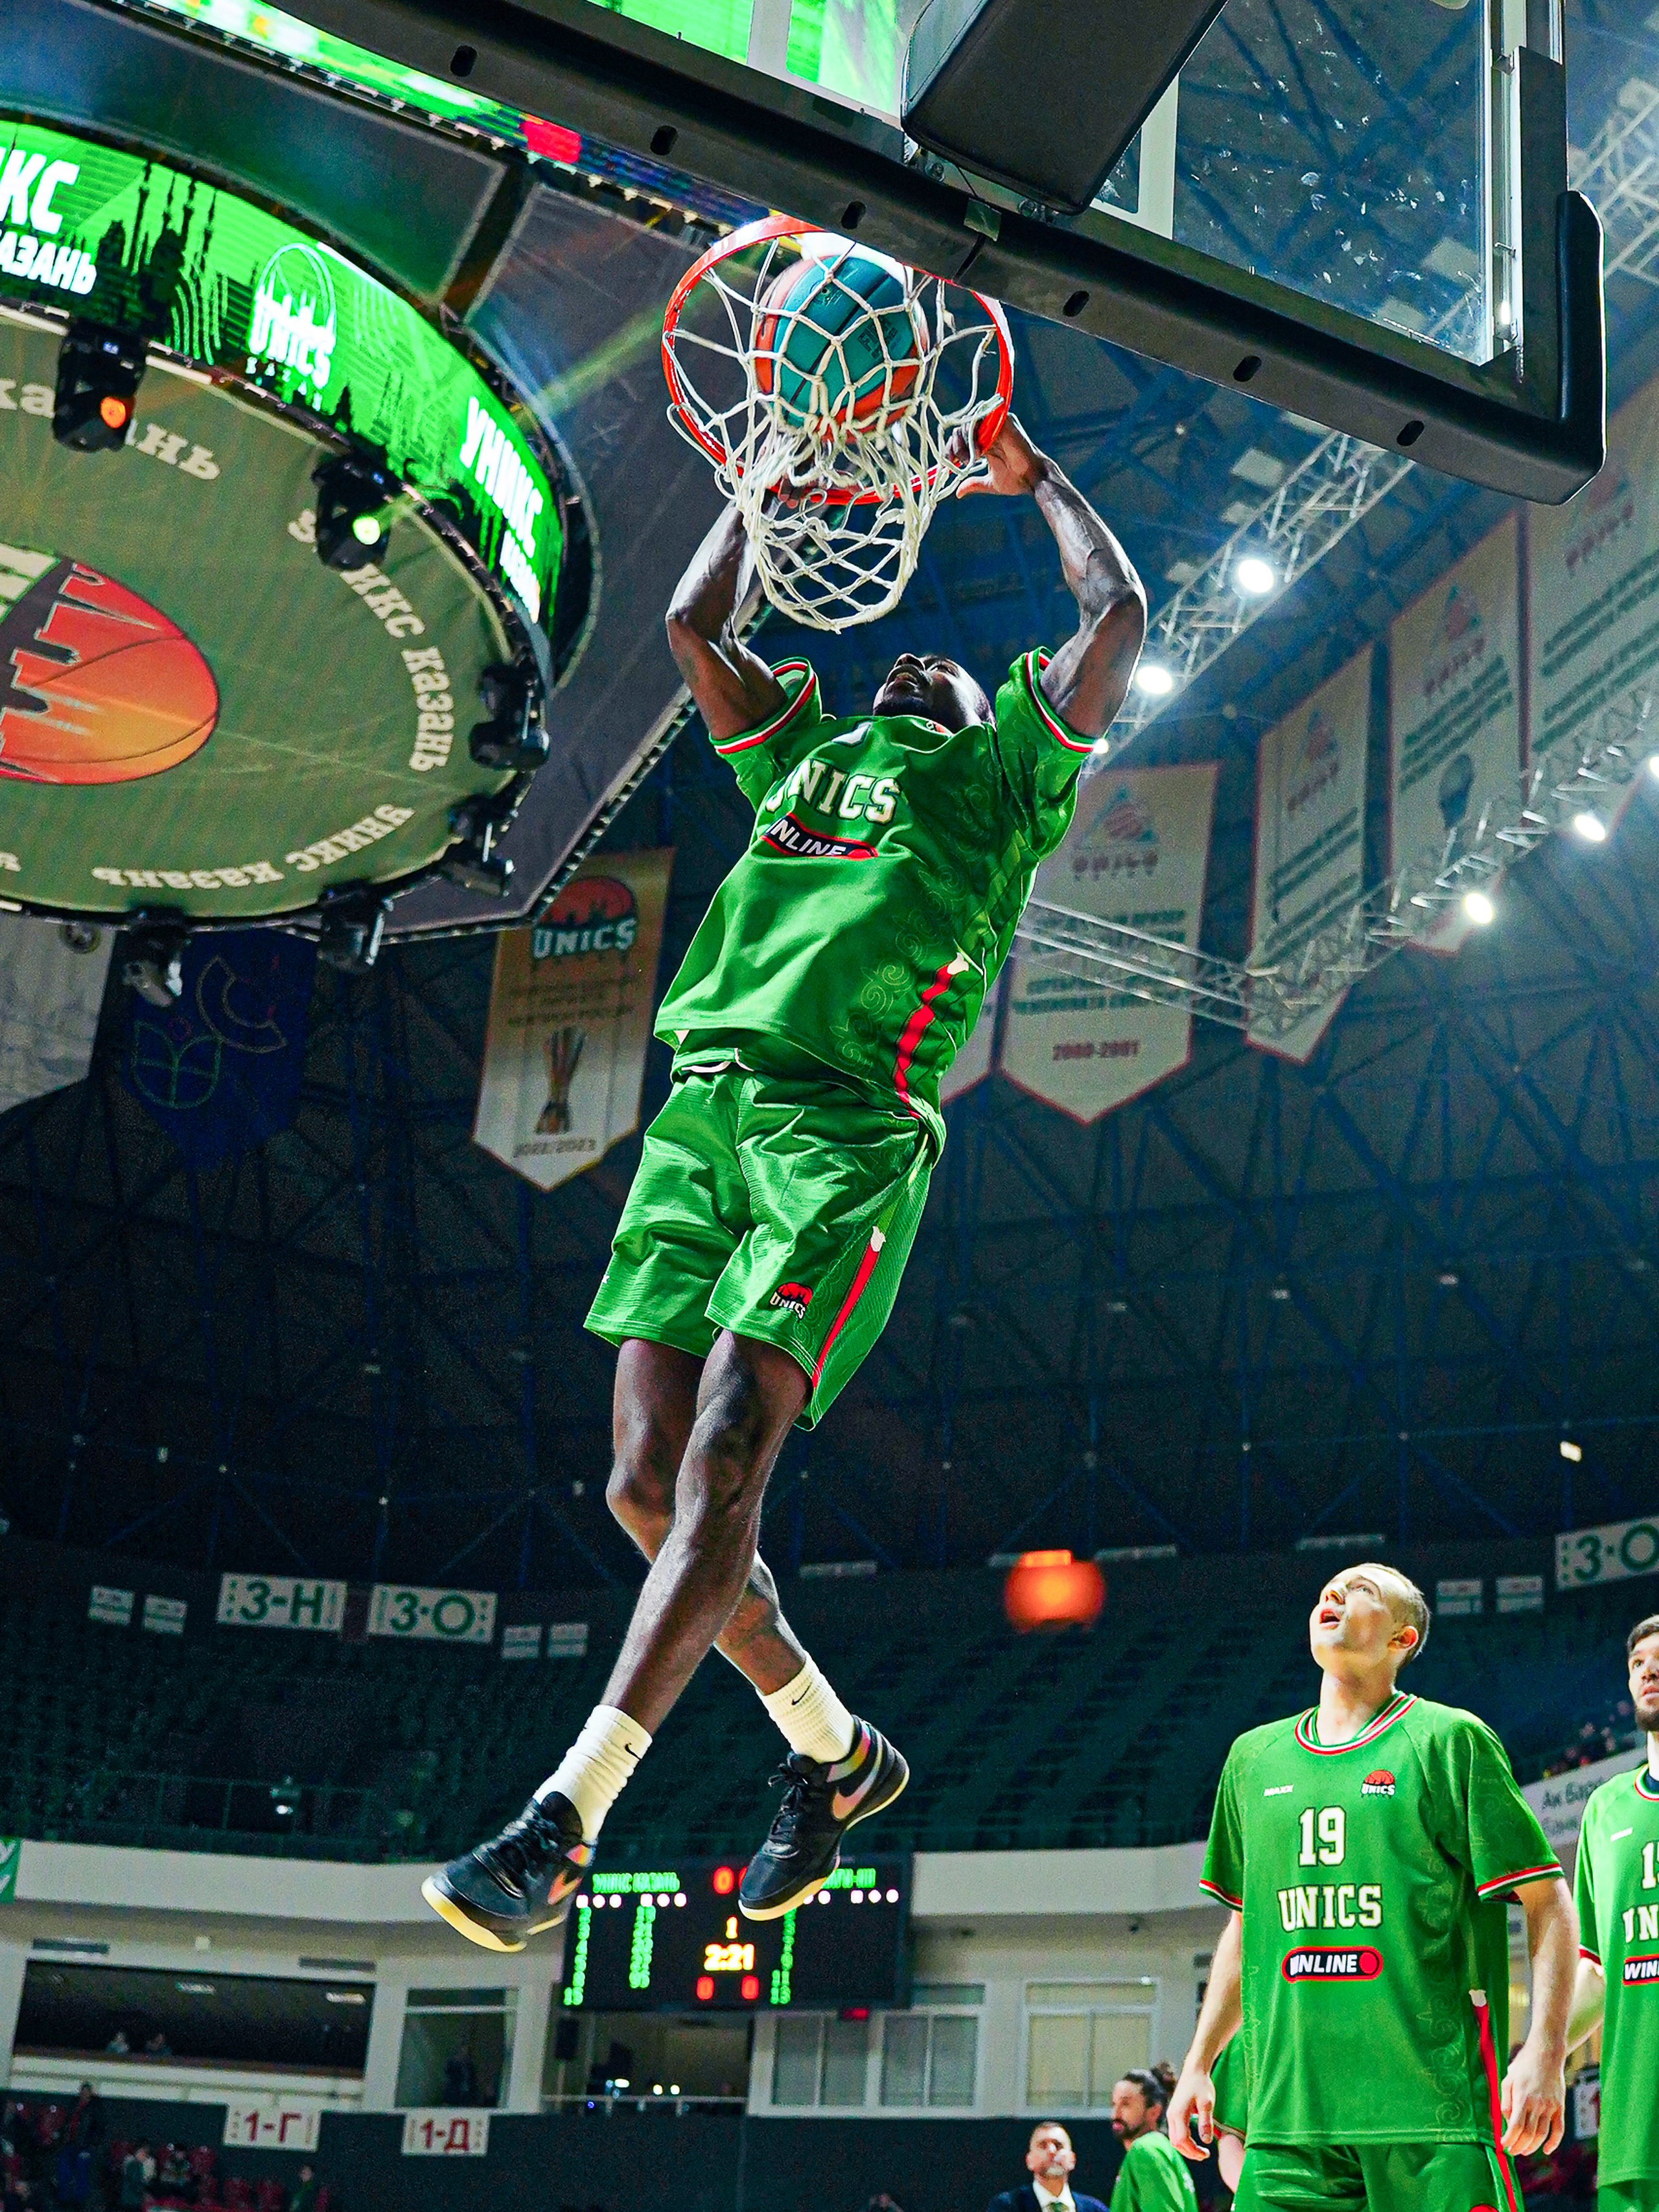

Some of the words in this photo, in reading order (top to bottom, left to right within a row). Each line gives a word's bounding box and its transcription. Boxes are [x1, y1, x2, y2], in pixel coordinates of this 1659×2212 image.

[0, 146, 80, 235] КС
[0, 229, 97, 295] АЗАНЬ
[401, 646, 454, 772] Казань
[767, 819, 846, 856] NLINE
[92, 861, 285, 889] Казань
[533, 916, 637, 959] UNICS
[770, 1292, 806, 1320] UNICS
[239, 1581, 324, 1625] 3-Н
[1361, 1784, 1395, 1796] UNICS
[1299, 1806, 1346, 1867] 19
[1642, 1842, 1659, 1889] 1
[1277, 1883, 1382, 1933] UNICS
[726, 1916, 737, 1938] 1
[704, 1943, 754, 1970] 2:21
[1290, 1954, 1358, 1975] NLINE
[1625, 1960, 1659, 1981] WIN
[245, 2110, 302, 2143] 1-Г
[420, 2117, 469, 2151] 1-Д
